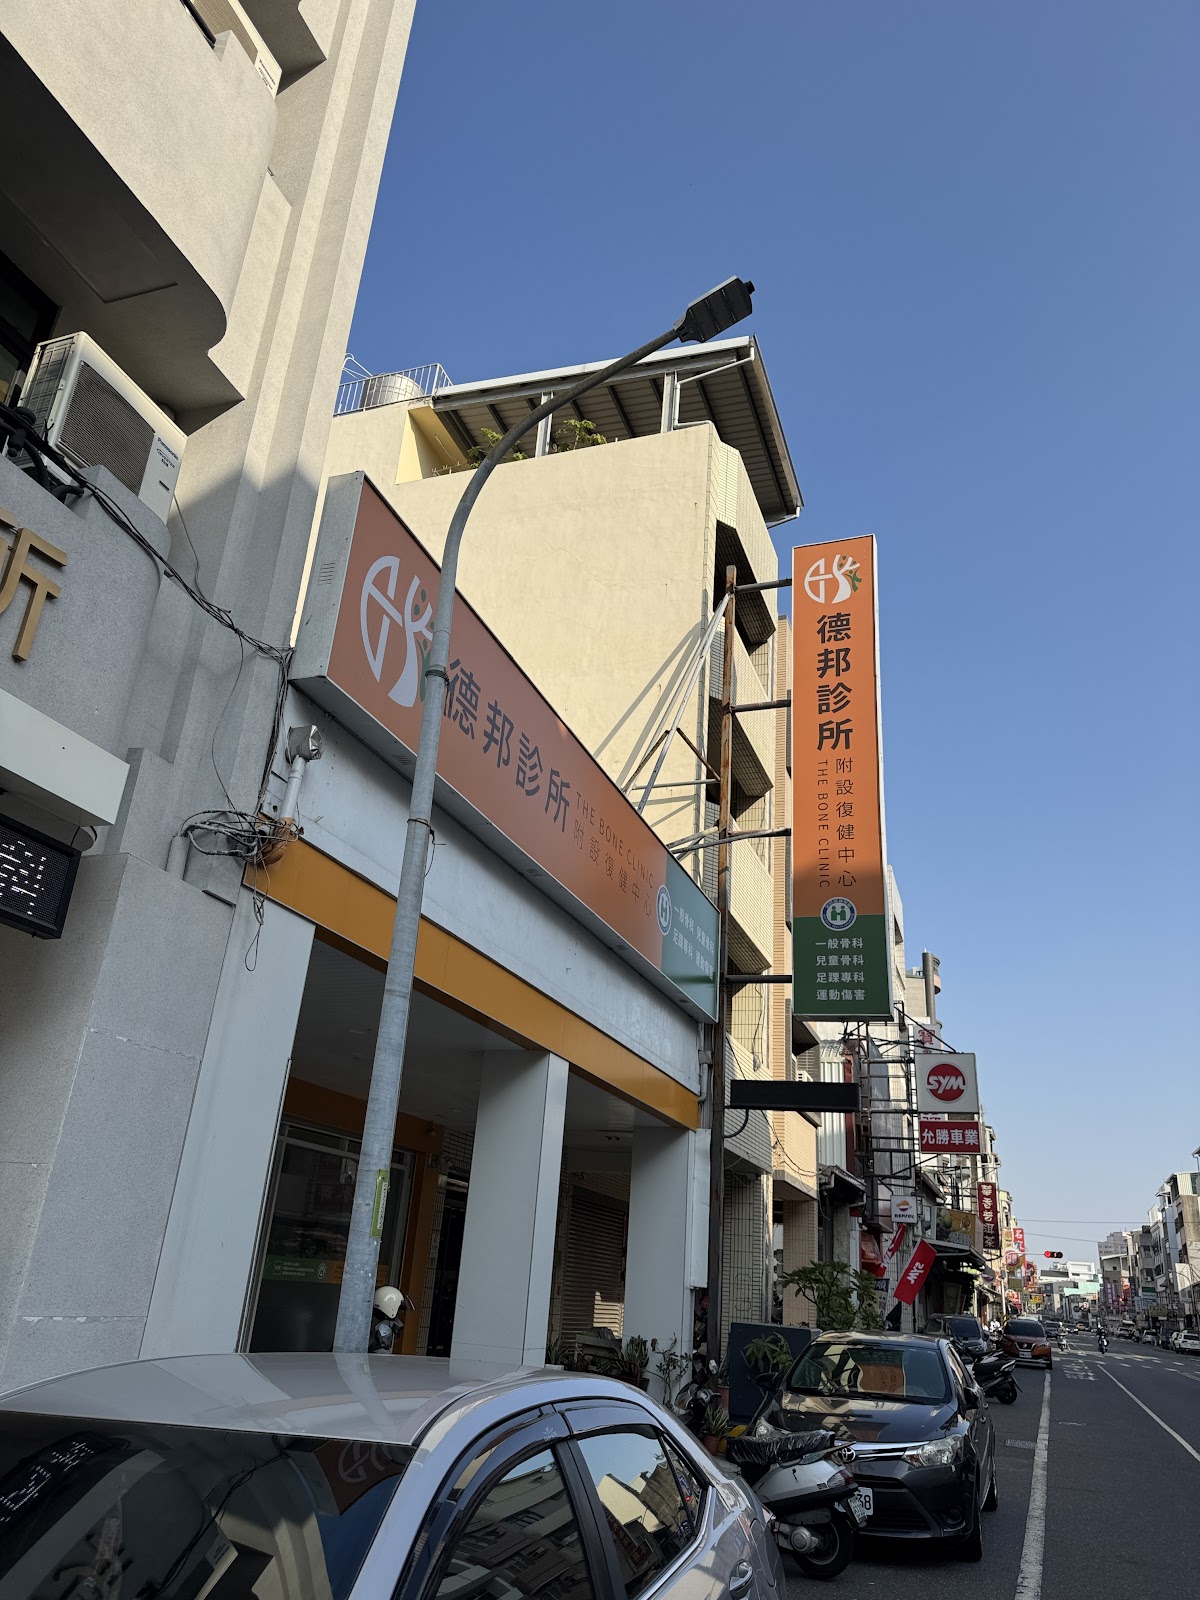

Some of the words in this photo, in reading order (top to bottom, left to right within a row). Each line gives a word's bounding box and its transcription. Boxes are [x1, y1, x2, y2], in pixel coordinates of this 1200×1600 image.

[816, 614, 853, 751] 德邦診所
[444, 658, 571, 833] 德邦診所
[817, 760, 829, 787] THE
[818, 793, 830, 833] BONE
[835, 758, 857, 888] 附設復健中心
[576, 791, 596, 826] THE
[599, 818, 624, 857] BONE
[626, 849, 654, 889] CLINIC
[574, 820, 652, 917] 附設復健中心
[818, 837, 831, 889] CLINIC
[815, 938, 864, 949] 一般骨科
[815, 954, 865, 966] 兒童骨科
[816, 972, 865, 983] 足踝專科
[816, 989, 866, 1001] 運動傷害
[926, 1075, 966, 1094] SYM
[922, 1129, 979, 1146] 允勝車業
